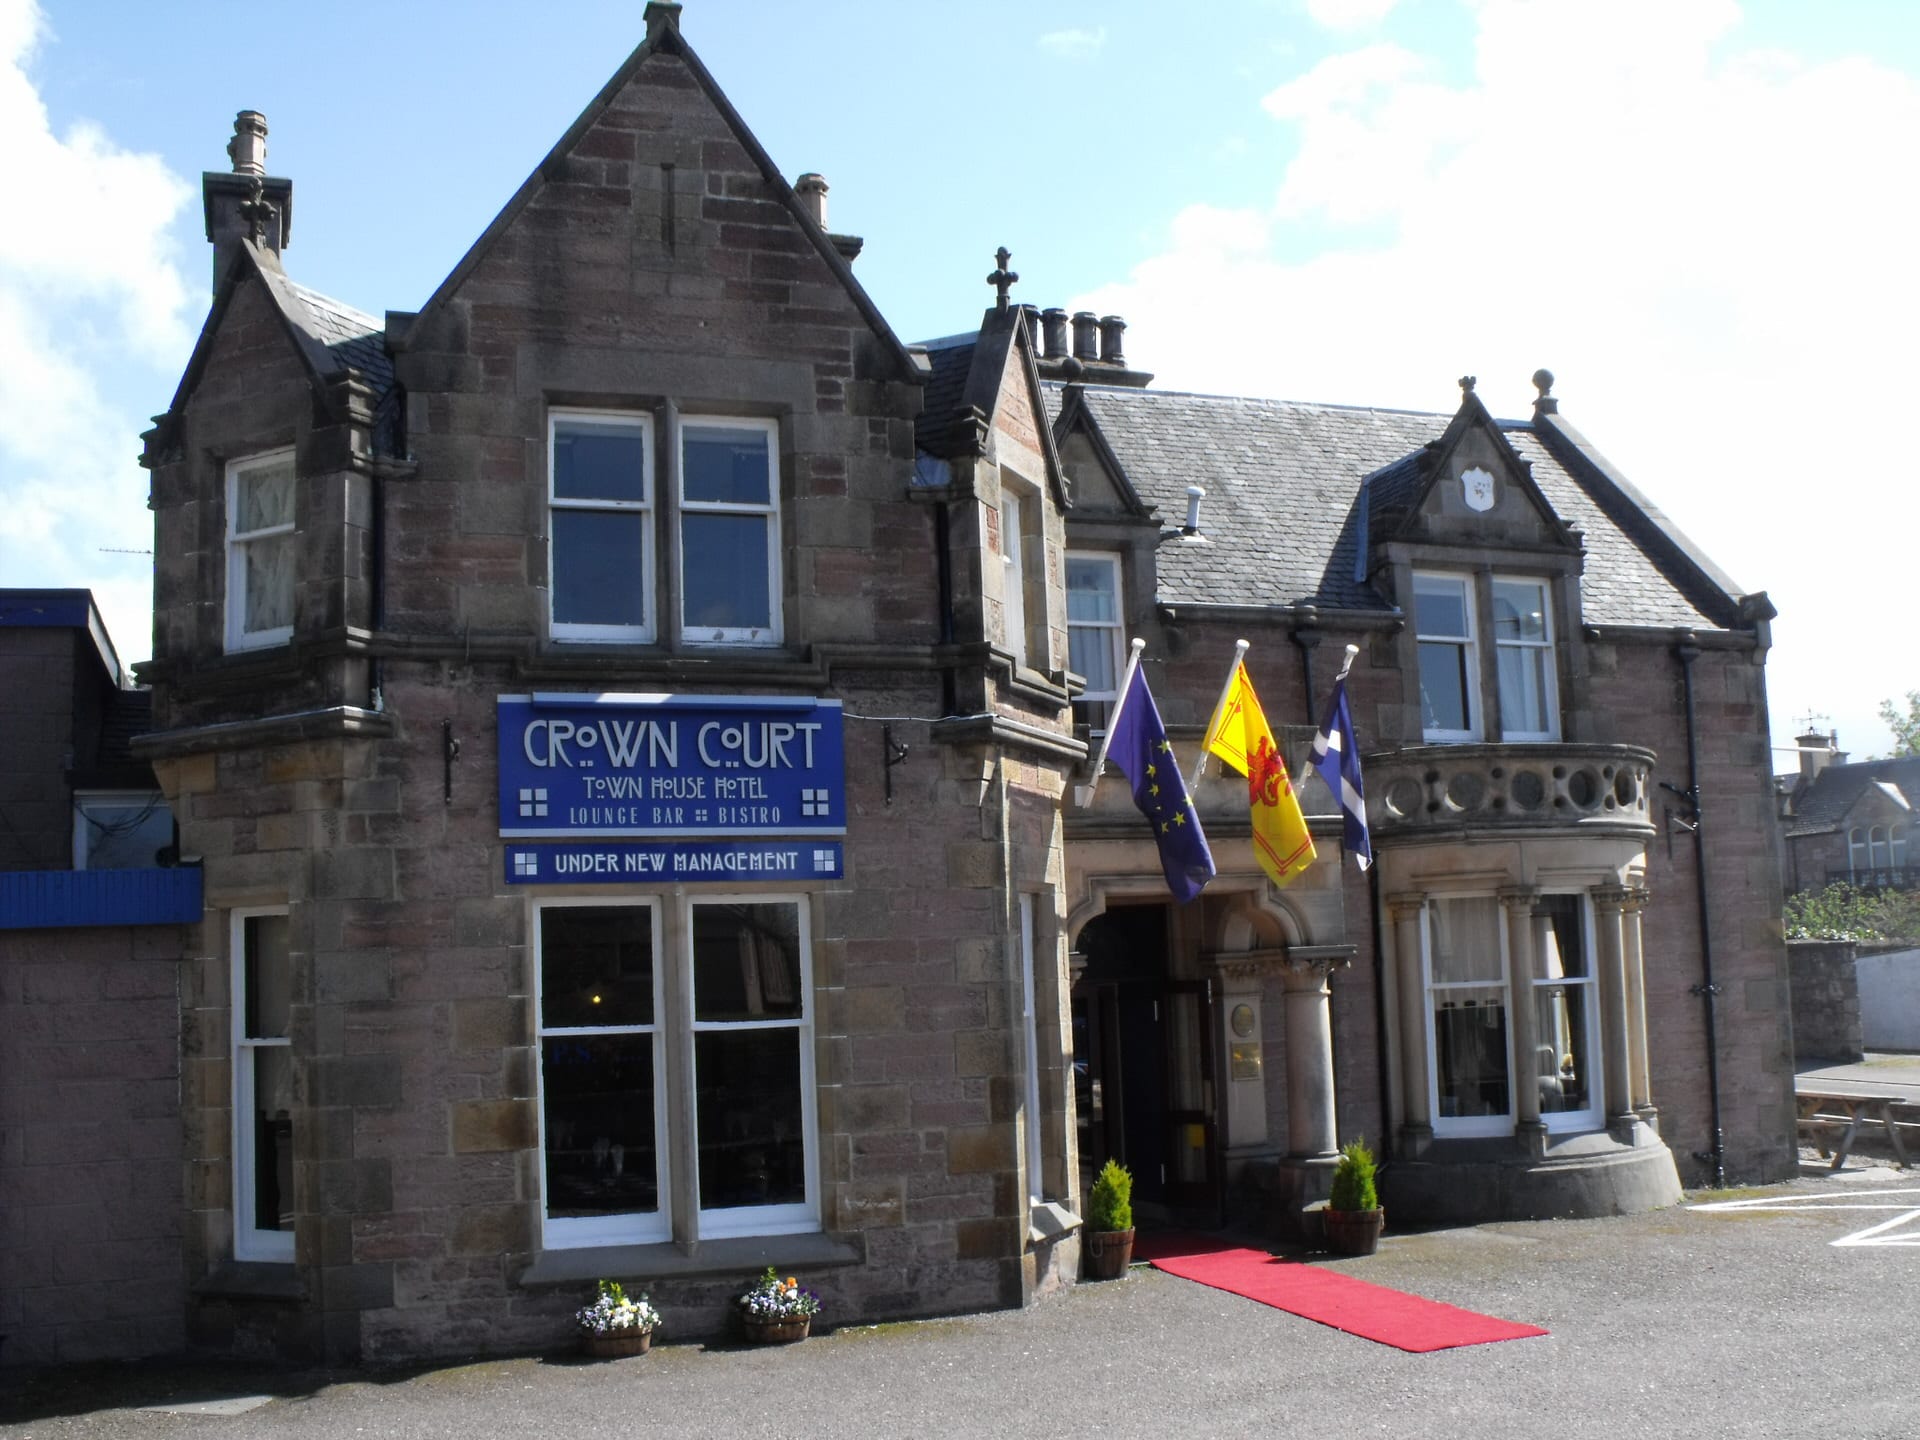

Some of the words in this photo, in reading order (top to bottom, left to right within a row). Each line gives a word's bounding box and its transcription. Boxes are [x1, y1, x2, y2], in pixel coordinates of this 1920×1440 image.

[524, 720, 678, 768] CROWN
[698, 721, 822, 769] COURT
[583, 777, 643, 799] TOWN
[651, 777, 706, 799] HOUSE
[715, 777, 768, 799] HOTEL
[570, 808, 638, 825] LOUNGE
[653, 808, 684, 824] BAR
[719, 806, 781, 824] BISTRO
[555, 853, 619, 873] UNDER
[625, 853, 666, 872] NEW
[674, 851, 798, 872] MANAGEMENT
